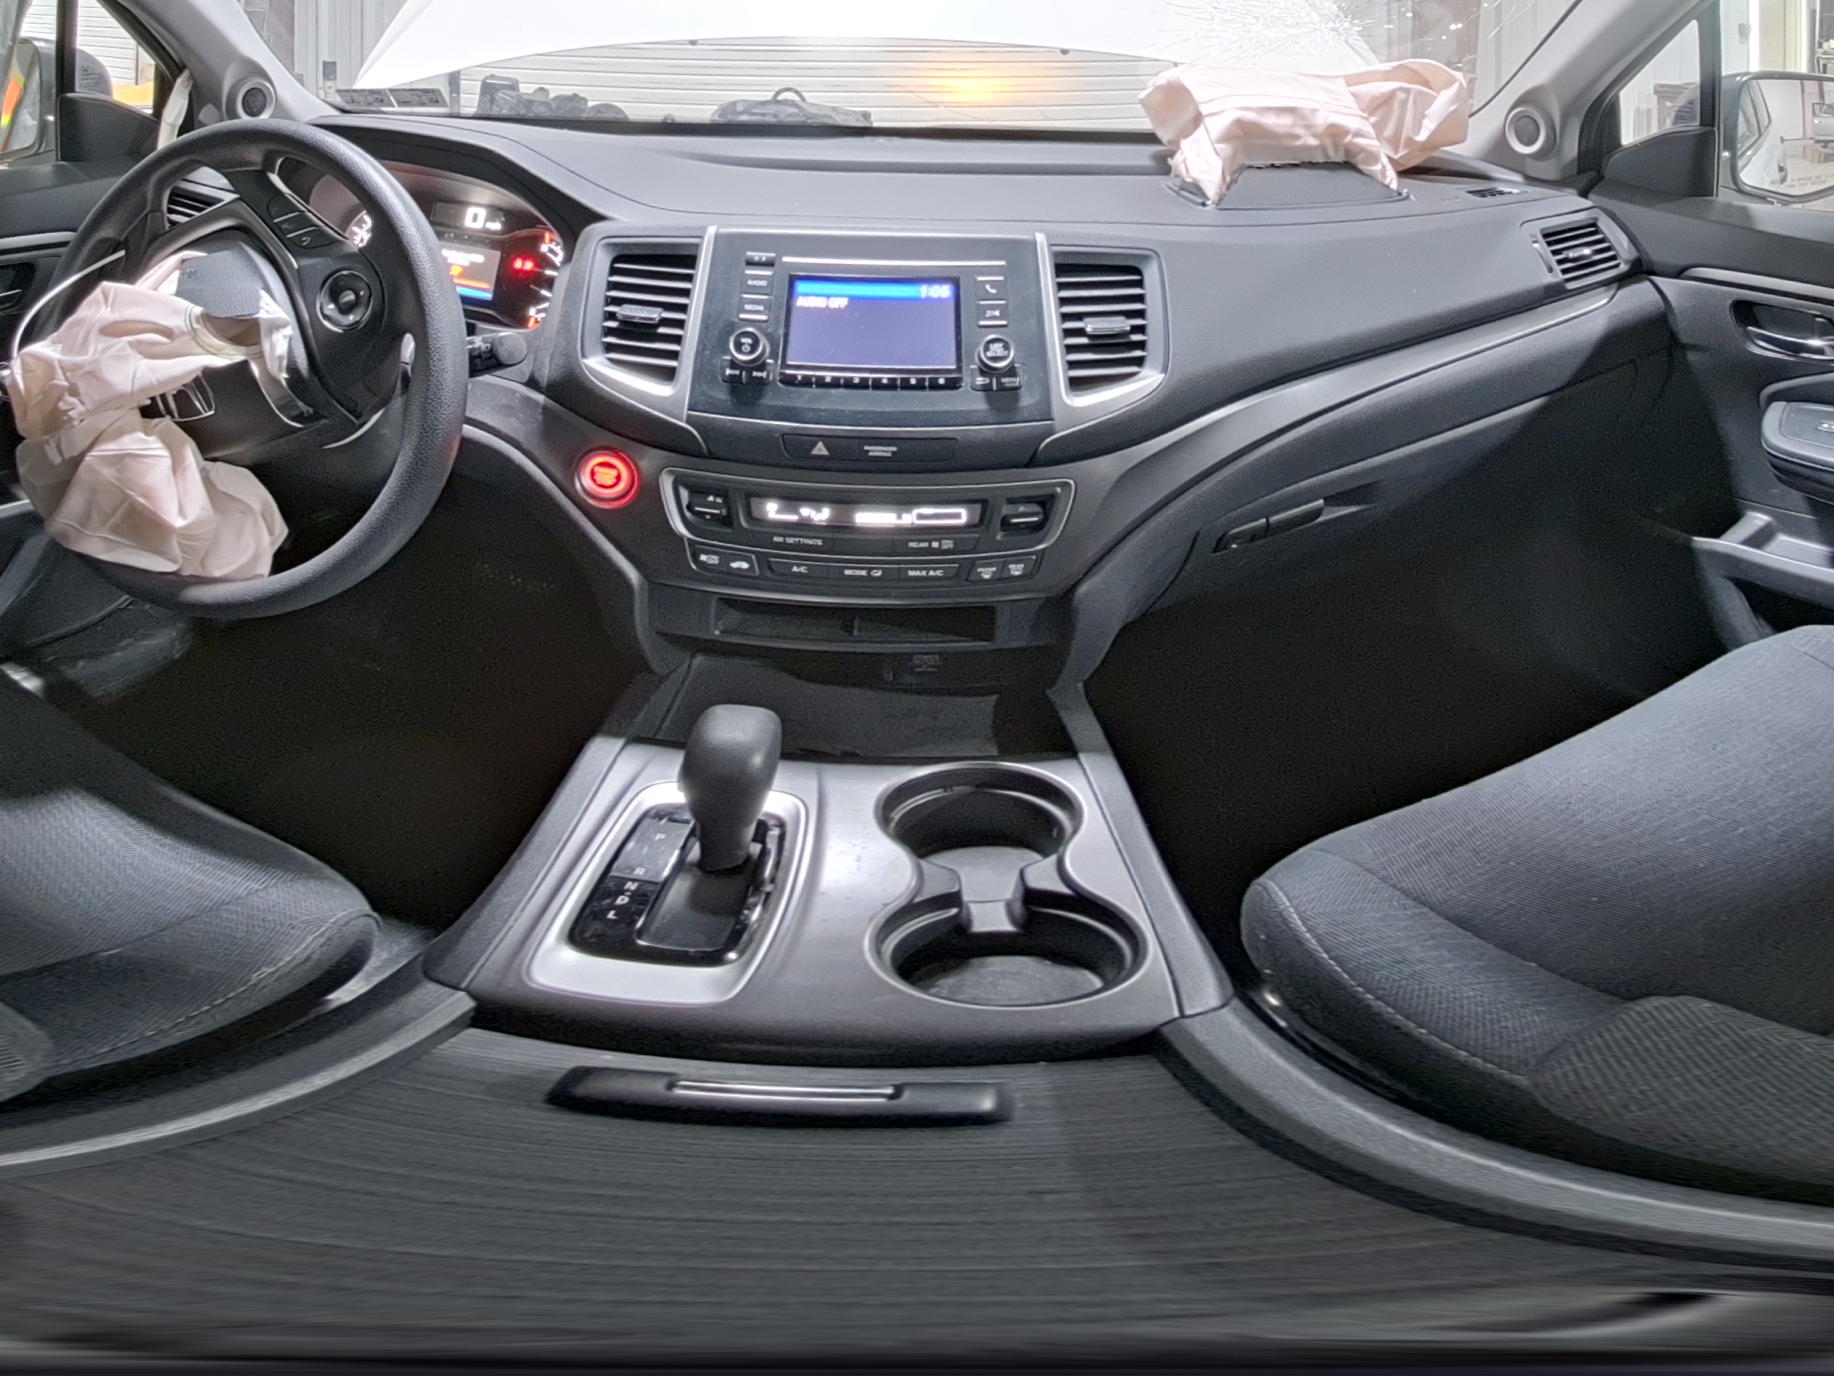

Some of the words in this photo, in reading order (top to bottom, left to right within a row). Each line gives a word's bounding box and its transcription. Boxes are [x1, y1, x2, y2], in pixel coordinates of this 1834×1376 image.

[796, 296, 827, 308] AUDIO
[828, 297, 848, 308] OFF
[785, 536, 823, 546] SETTINGS
[791, 565, 809, 573] A/C
[654, 832, 665, 842] P
[625, 881, 637, 891] N
[616, 895, 628, 905] D
[607, 909, 618, 919] L
